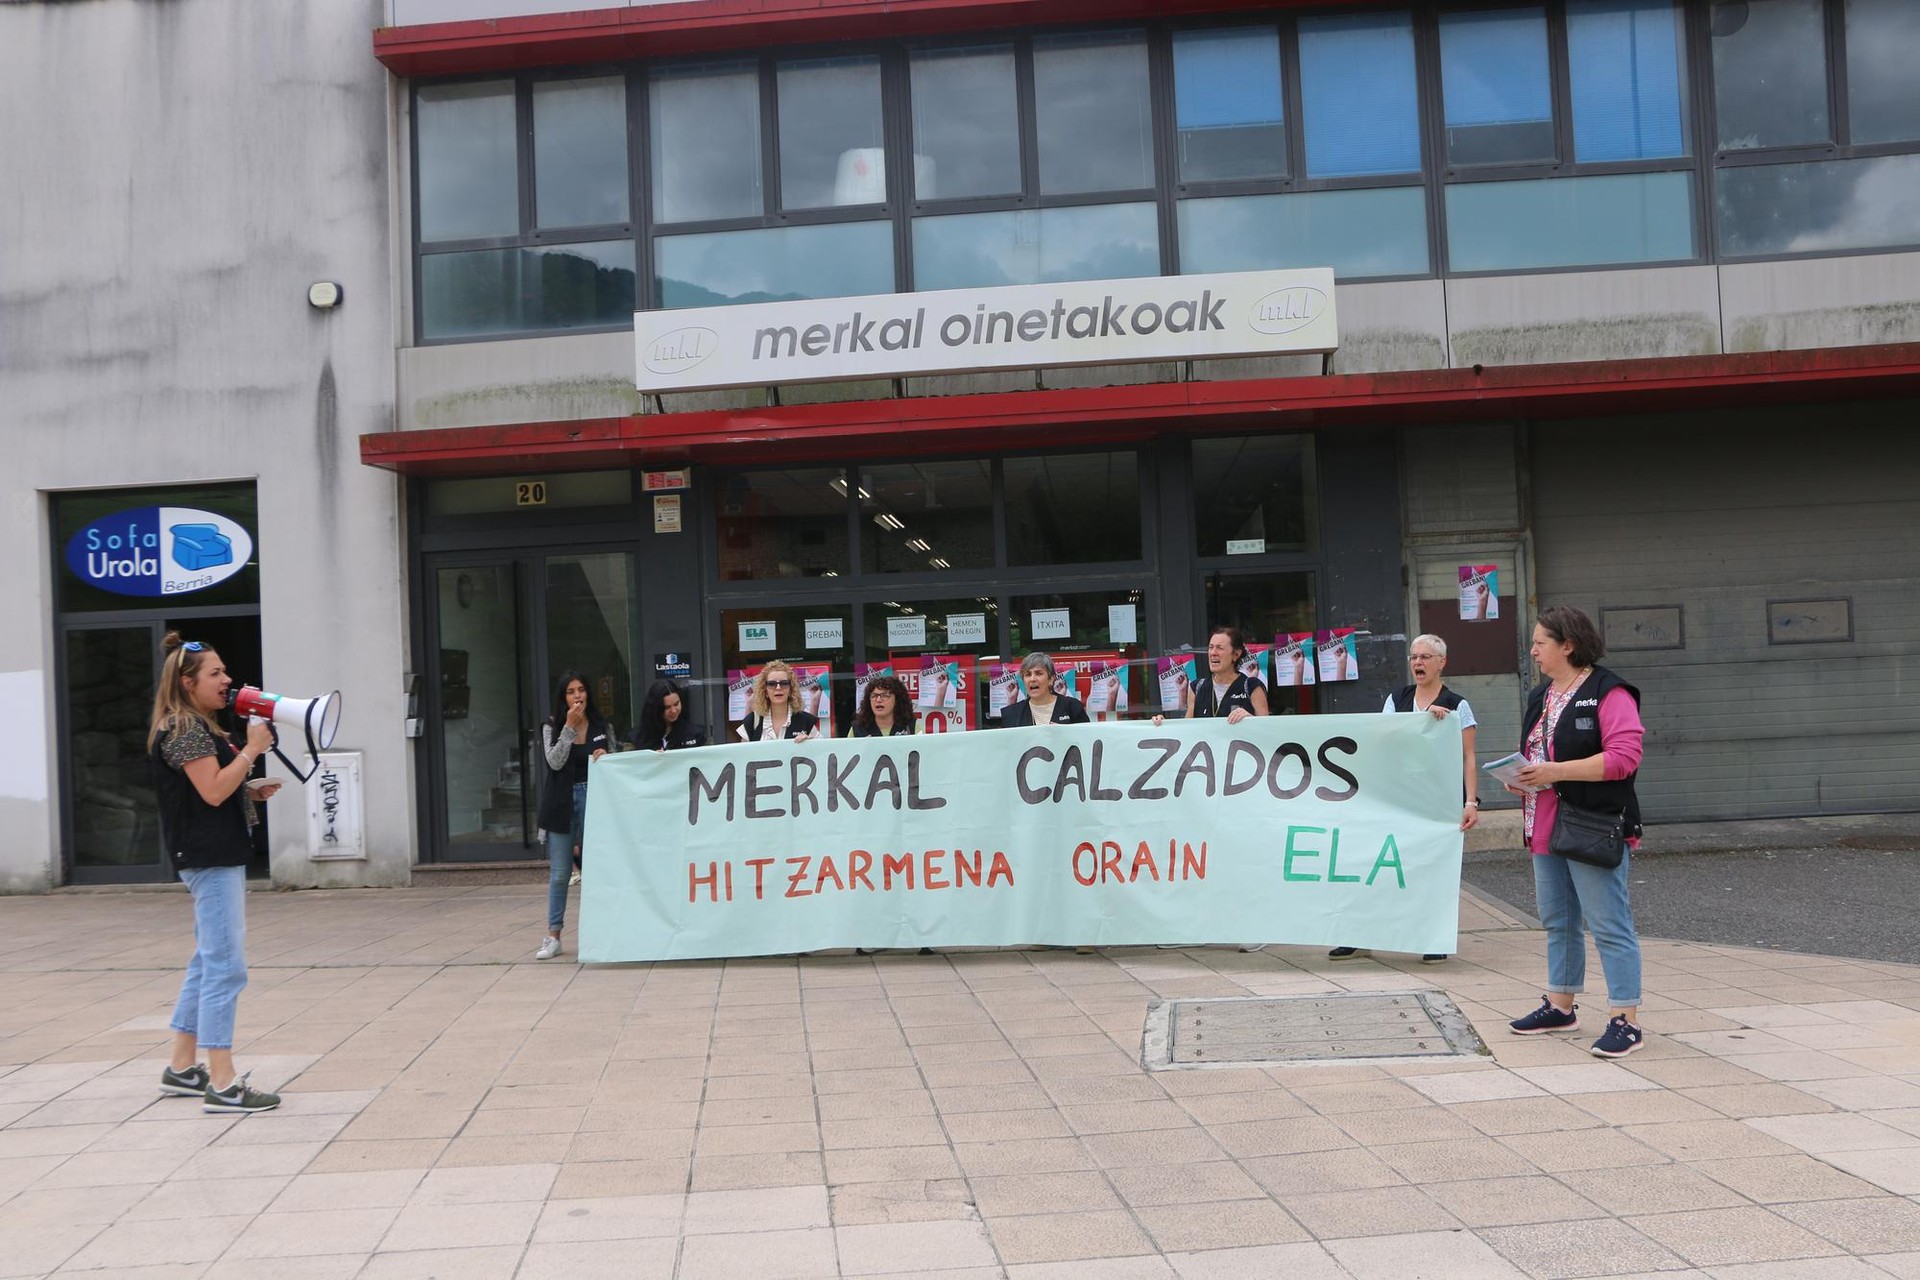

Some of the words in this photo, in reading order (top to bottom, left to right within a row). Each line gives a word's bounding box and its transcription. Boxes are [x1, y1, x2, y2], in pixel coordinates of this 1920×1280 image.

[752, 307, 925, 360] merkal
[940, 290, 1227, 347] oinetakoak
[519, 484, 543, 503] 20
[86, 524, 157, 550] Sofa
[88, 547, 158, 578] Urola
[164, 574, 213, 592] Berria
[745, 628, 768, 638] ELA
[950, 628, 965, 636] LAN
[965, 627, 982, 635] EGIN
[1037, 620, 1065, 630] ITXITA
[806, 630, 842, 640] GREBAN
[1575, 698, 1598, 708] merka
[688, 750, 947, 826] MERKAL
[1016, 736, 1359, 804] CALZADOS
[688, 850, 1015, 902] HITZARMENA
[1072, 838, 1208, 886] ORAIN
[1283, 825, 1406, 889] ELA
